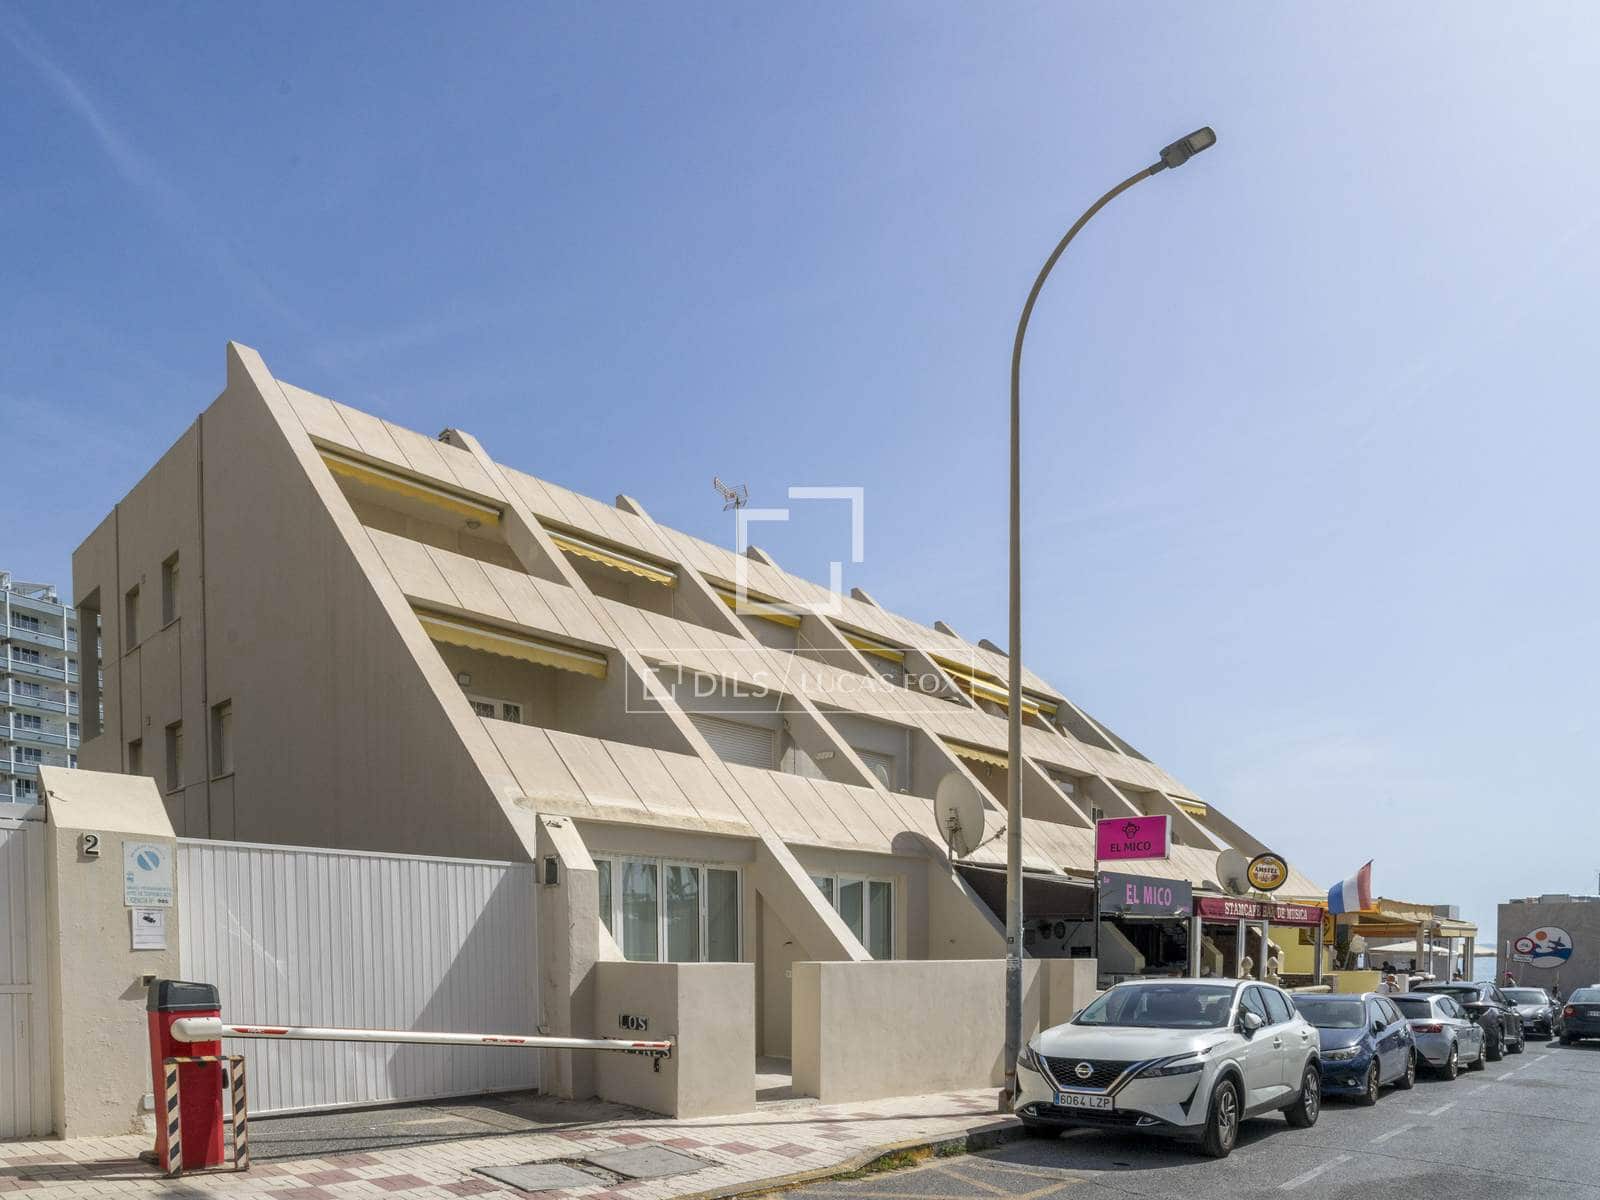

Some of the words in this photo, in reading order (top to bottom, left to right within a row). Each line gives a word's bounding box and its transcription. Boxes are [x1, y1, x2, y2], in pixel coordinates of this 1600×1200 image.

[85, 835, 99, 855] 2
[1110, 843, 1121, 853] EL
[1124, 841, 1152, 852] MICO
[1126, 883, 1139, 904] EL
[1143, 885, 1172, 906] MICO
[619, 1014, 648, 1031] LOS
[1060, 1094, 1086, 1106] 6064
[1089, 1096, 1110, 1108] LZP
